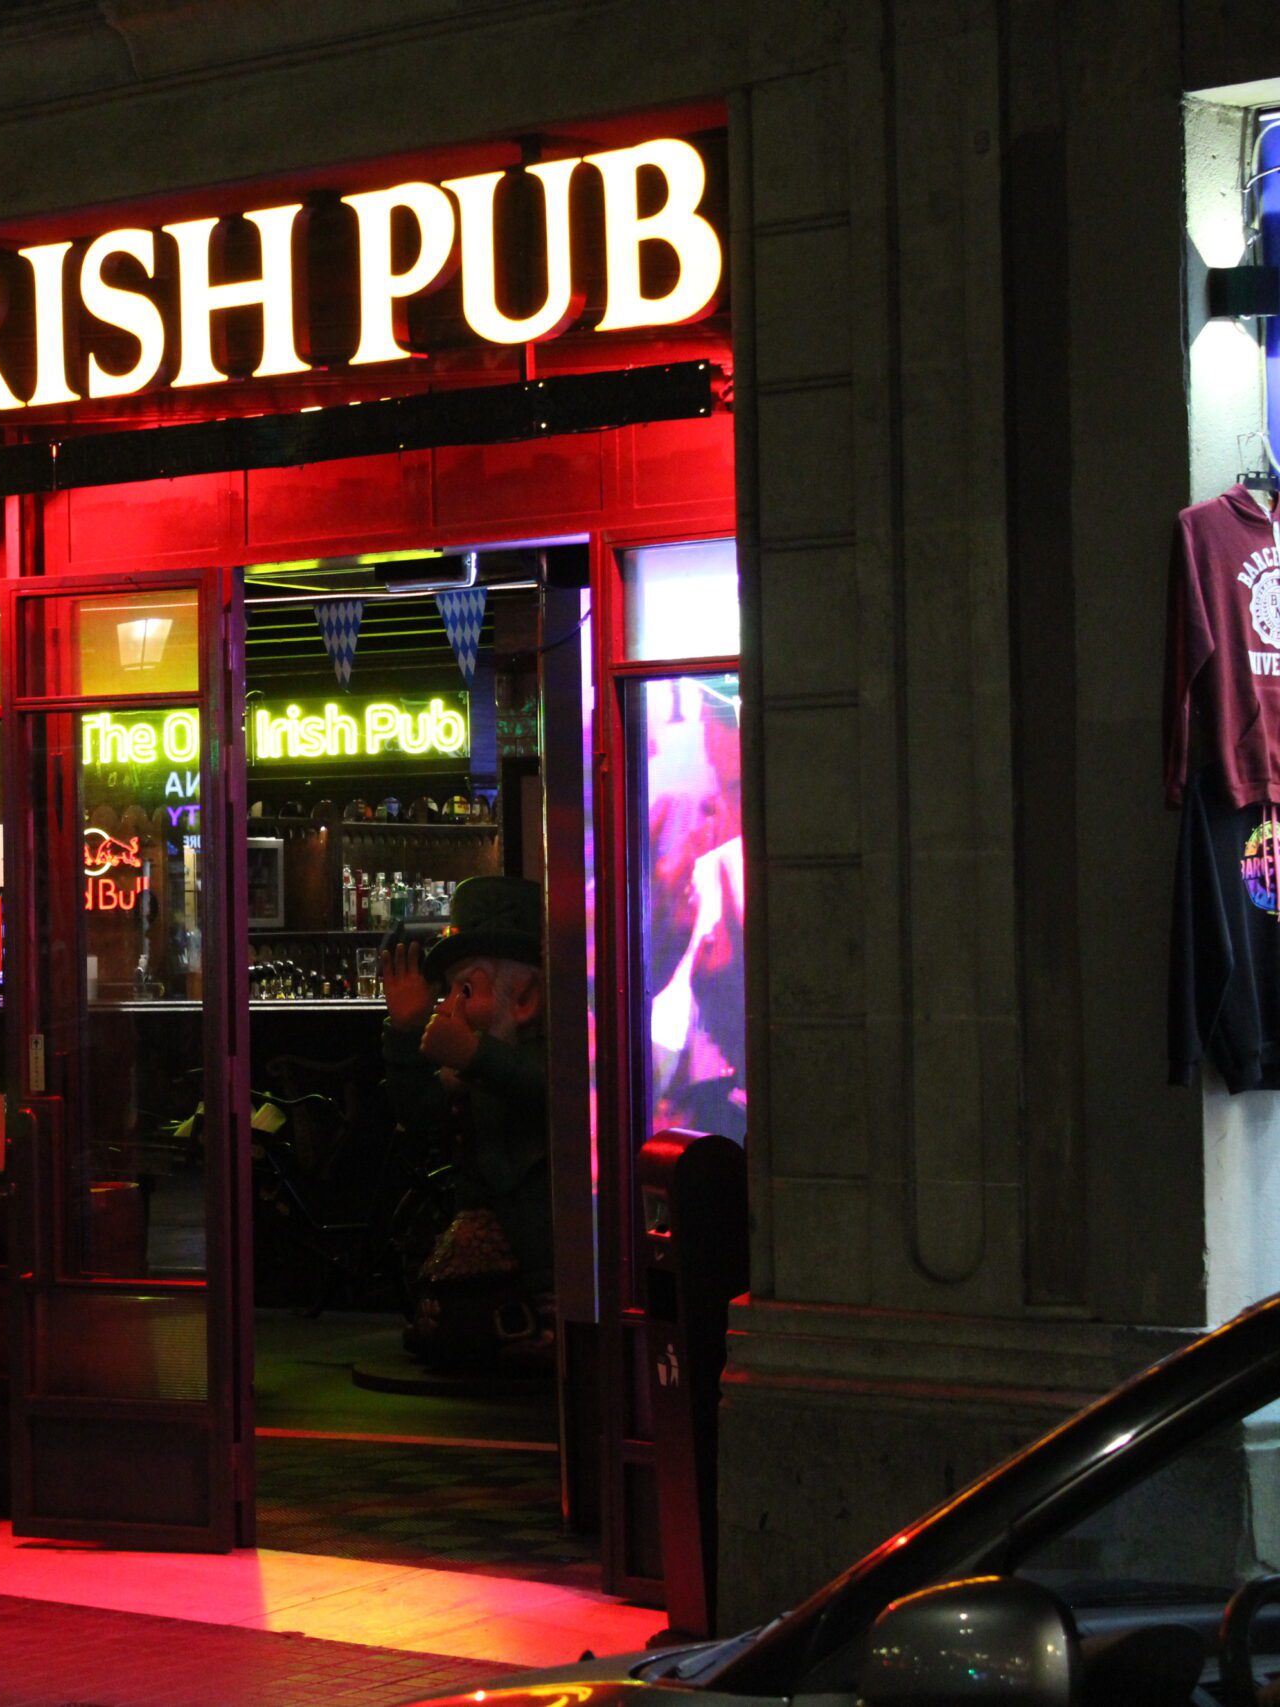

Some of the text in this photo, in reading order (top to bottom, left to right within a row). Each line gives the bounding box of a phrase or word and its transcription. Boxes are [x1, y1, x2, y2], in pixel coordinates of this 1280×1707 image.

[341, 138, 722, 366] PUB
[81, 712, 157, 765] The
[256, 703, 358, 758] Irish
[365, 698, 466, 754] Pub
